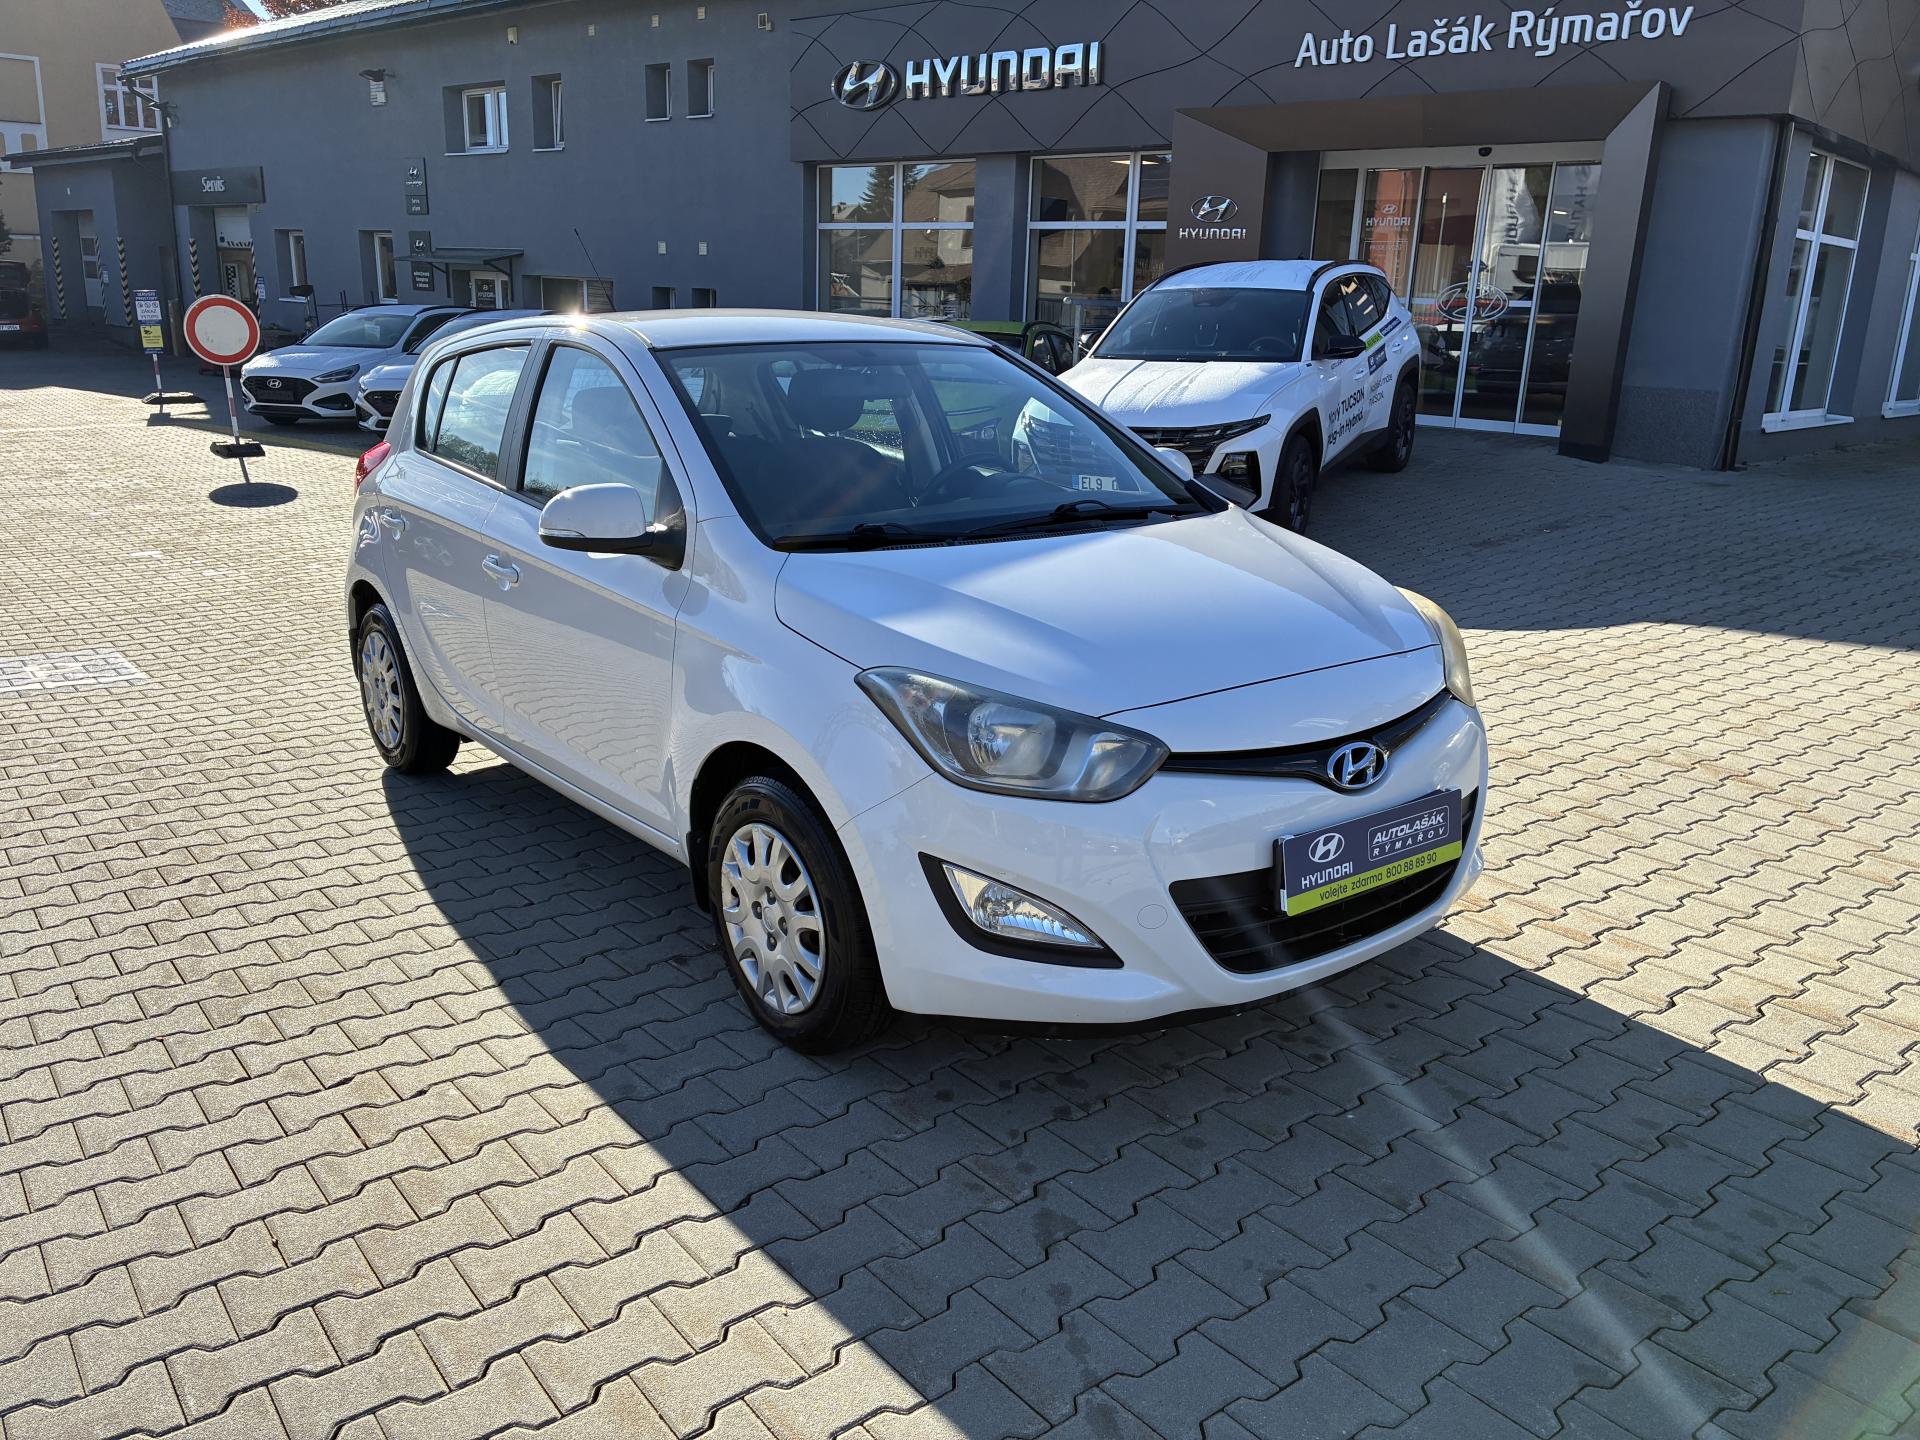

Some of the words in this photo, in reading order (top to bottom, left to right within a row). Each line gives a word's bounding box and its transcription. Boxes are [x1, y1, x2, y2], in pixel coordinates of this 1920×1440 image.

[1294, 29, 1375, 68] Auto
[1385, 14, 1496, 60] Lašák
[1506, 0, 1694, 57] Rýmařov
[905, 41, 1103, 99] HYUNDAI
[201, 175, 226, 192] Servis
[1179, 228, 1247, 240] HYUNDAI
[1366, 216, 1411, 227] HYUNDAI
[1341, 386, 1365, 414] TUCSON
[1372, 811, 1445, 844] AUTOLAŠÁK
[1372, 827, 1445, 857] RÝMAŘOV
[1301, 861, 1353, 889] HYUNDAI
[1319, 883, 1348, 901] volejte
[1351, 872, 1383, 890] zdarma
[1386, 864, 1402, 878] 800
[1403, 860, 1414, 873] 88
[1415, 857, 1425, 869] 89
[1426, 852, 1437, 864] 90
